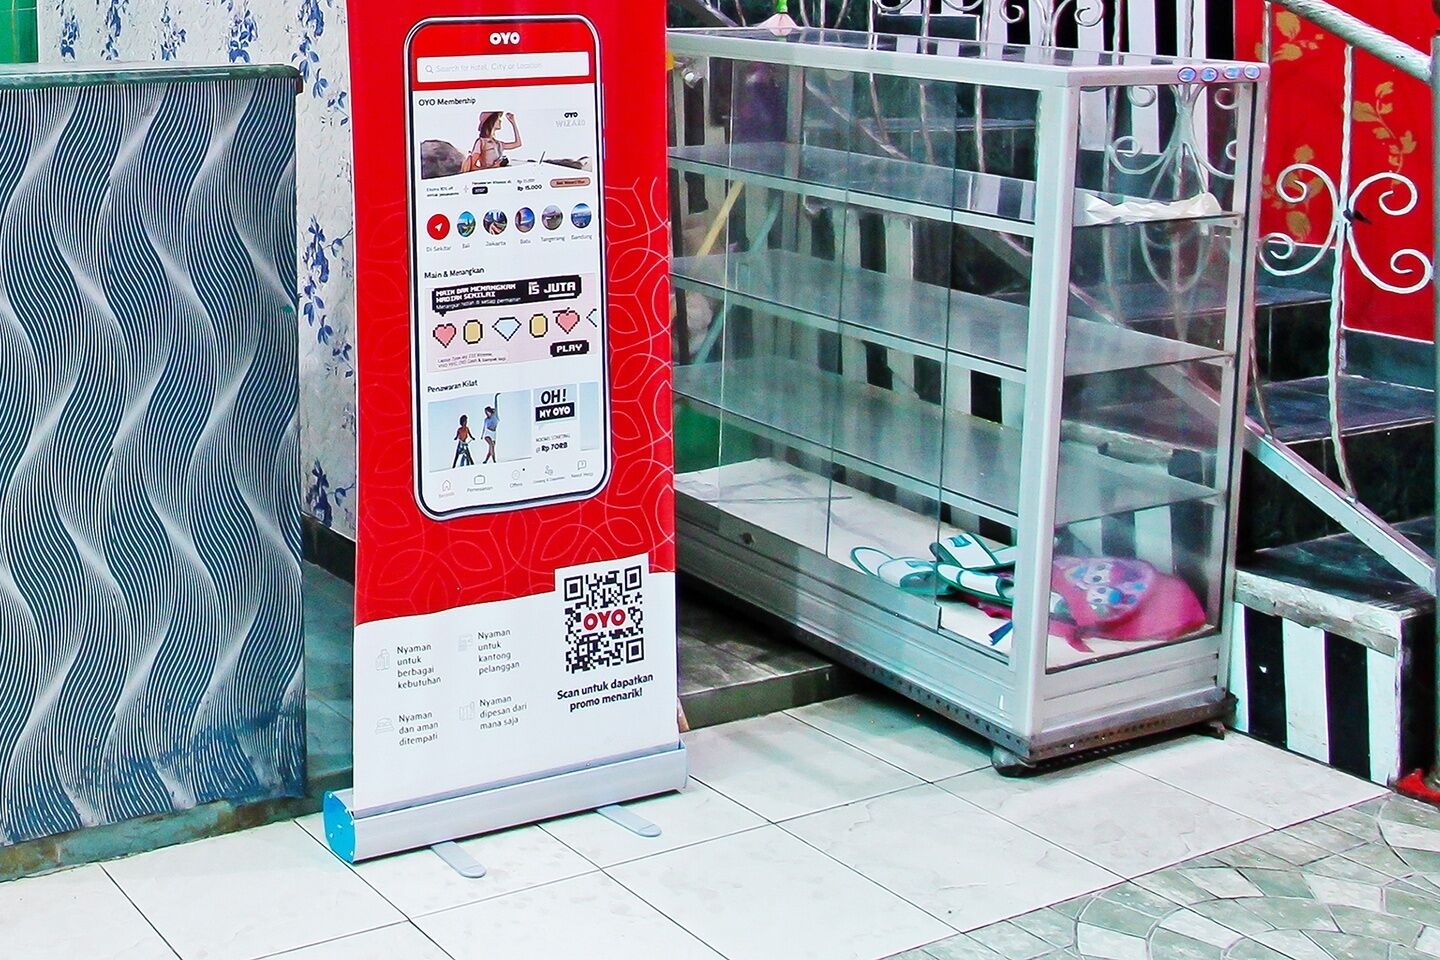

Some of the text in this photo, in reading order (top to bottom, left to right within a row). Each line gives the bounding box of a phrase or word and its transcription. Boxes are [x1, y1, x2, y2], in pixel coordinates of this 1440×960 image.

[490, 32, 520, 45] OYO
[437, 98, 476, 106] Membership
[424, 271, 443, 279] Main
[543, 281, 576, 294] JUTA
[556, 343, 583, 353] PLAY
[427, 379, 478, 393] Penawaran Kilat
[540, 388, 567, 405] OH!
[539, 406, 571, 419] MY OYO
[541, 443, 550, 453] Rp
[583, 609, 626, 631] OYO
[478, 629, 511, 640] Nyaman
[396, 644, 432, 655] Nyaman
[478, 641, 502, 651] untuk
[397, 656, 422, 666] untuk
[478, 652, 511, 662] kantong
[397, 666, 435, 678] berbagai
[479, 661, 520, 676] pelanggan
[397, 676, 441, 689] kebutuhan
[557, 674, 654, 700] Scan untuk dapatkan
[479, 695, 512, 707] Nyaman
[569, 687, 643, 712] promo menarik!
[398, 711, 433, 723] Nyaman
[479, 703, 527, 719] dipesan dari
[399, 722, 439, 735] dan aman
[480, 717, 519, 730] mana saja
[399, 732, 438, 746] ditempati
